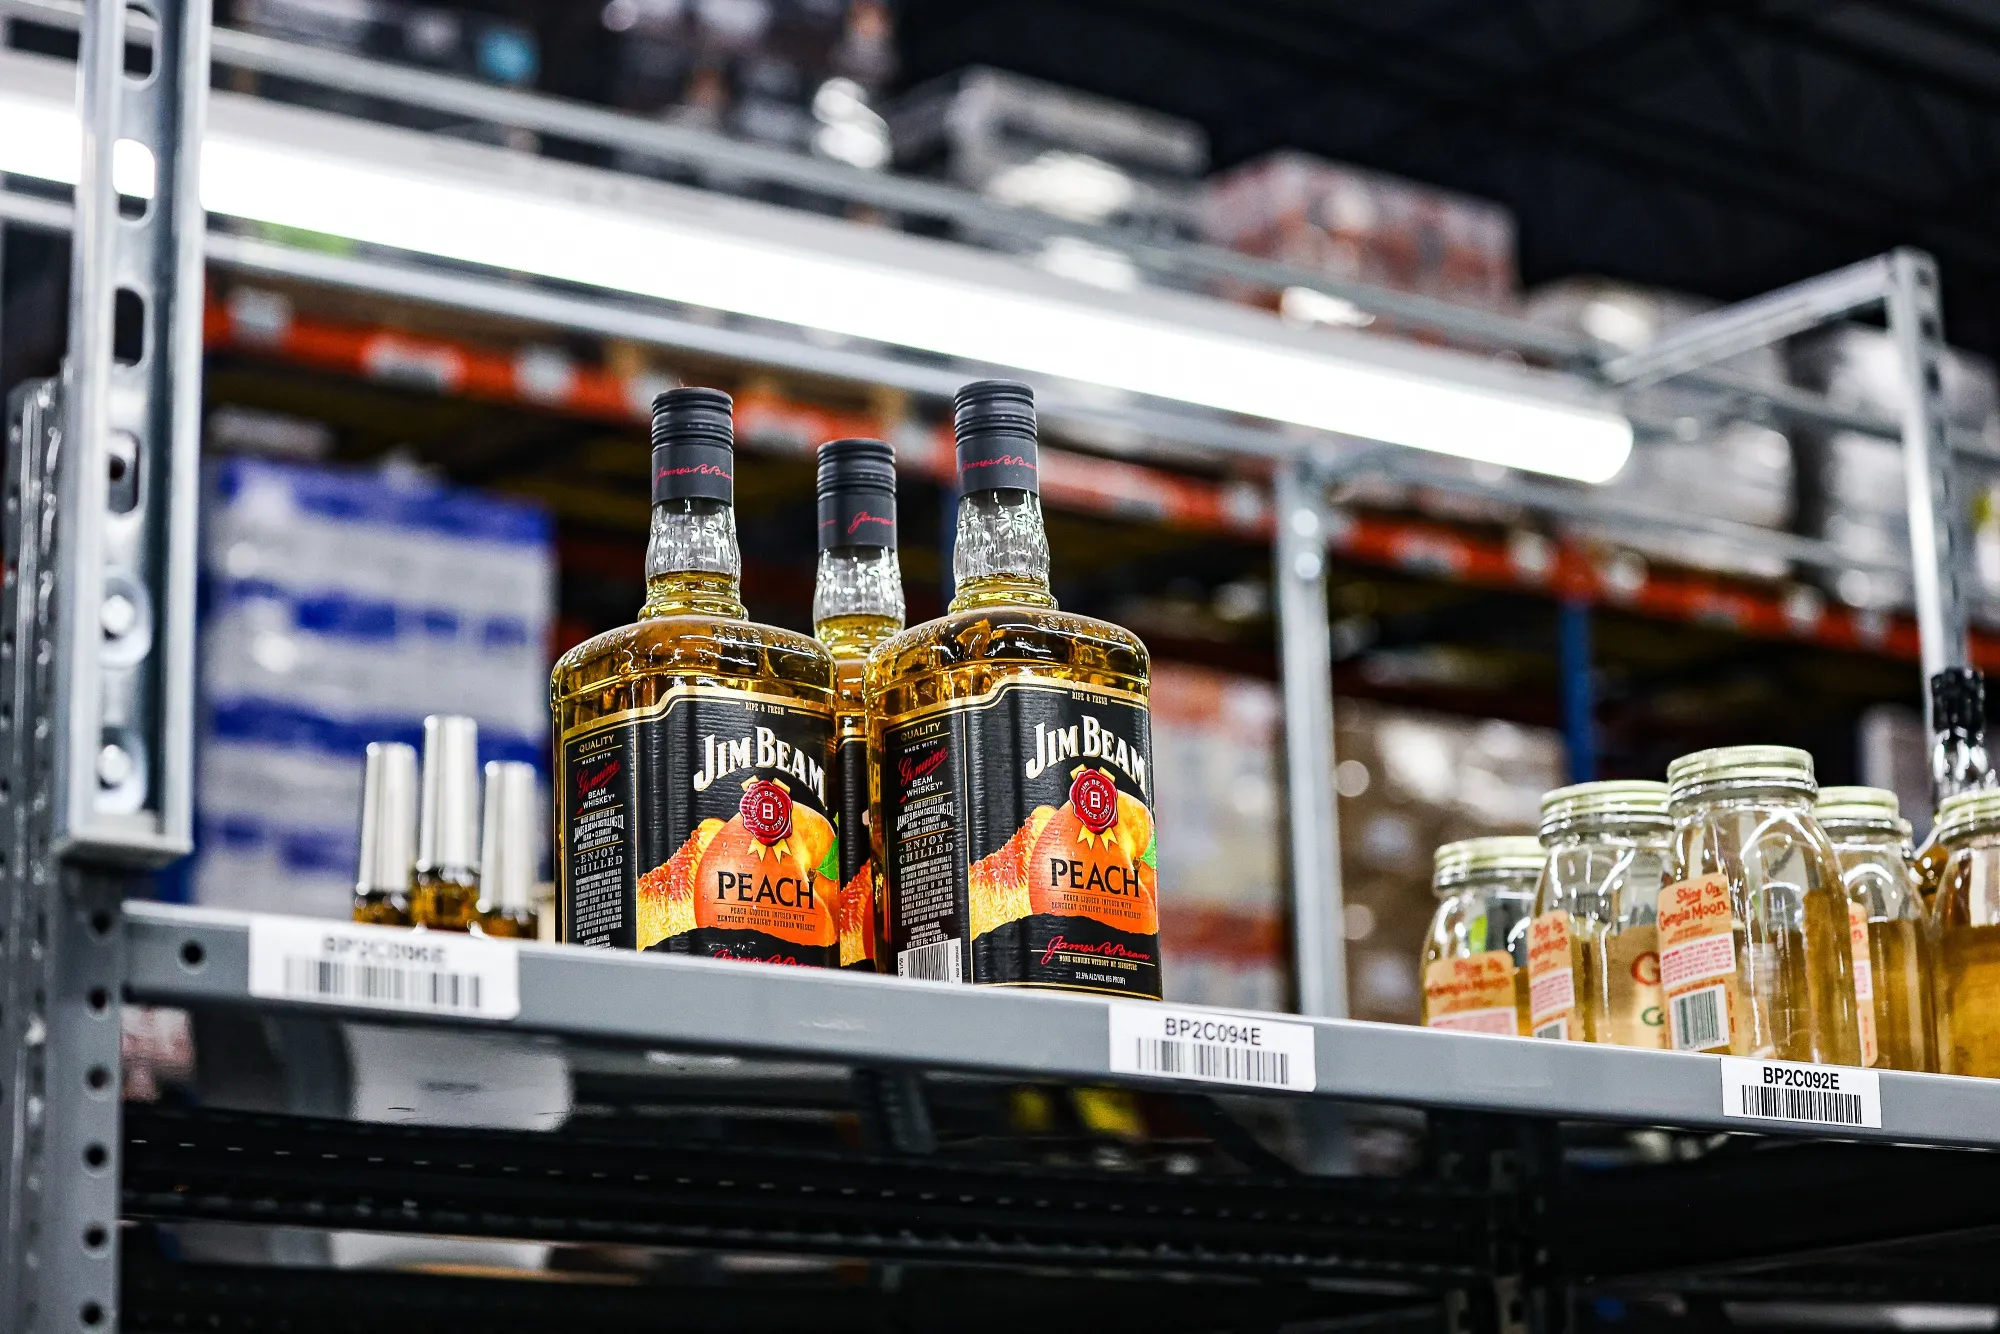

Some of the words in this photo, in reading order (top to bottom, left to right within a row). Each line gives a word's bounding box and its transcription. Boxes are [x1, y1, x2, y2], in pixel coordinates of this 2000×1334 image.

[900, 721, 941, 742] QUALITY
[579, 734, 615, 753] QUALITY
[904, 744, 920, 754] MADE
[921, 739, 938, 749] WITH
[581, 756, 596, 766] MADE
[596, 751, 612, 761] WITH
[1025, 721, 1080, 780] JIM
[1081, 714, 1146, 798] BEAM
[693, 733, 752, 792] JIM
[755, 726, 827, 810] BEAM
[898, 747, 949, 787] Genuine
[912, 775, 933, 788] BEAM
[587, 787, 607, 800] BEAM
[906, 832, 945, 853] ENJOY
[580, 846, 616, 864] ENJOY
[899, 842, 954, 865] CHILLED
[575, 855, 623, 877] CHILLED
[1049, 858, 1141, 898] PEACH
[716, 871, 815, 910] PEACH
[730, 906, 747, 915] PEACH
[793, 913, 805, 922] WITH
[747, 917, 772, 926] STRAIGHT
[1040, 935, 1095, 966] James
[1112, 943, 1151, 960] Beam
[1165, 1017, 1262, 1046] BP2C094E
[1763, 1066, 1840, 1091] BP2C092E
